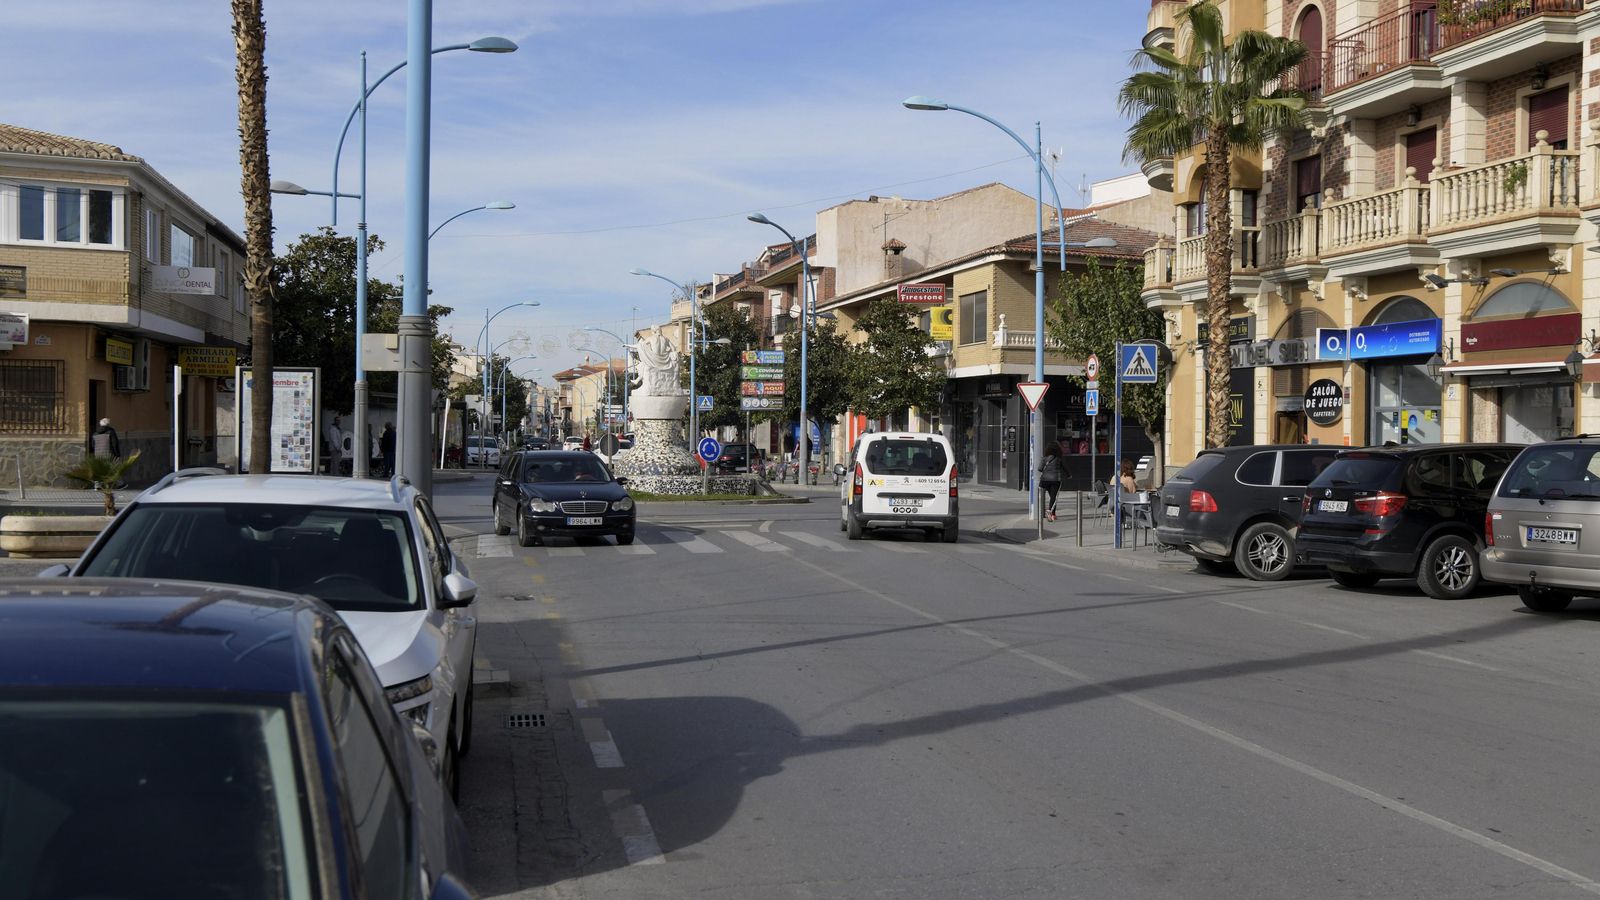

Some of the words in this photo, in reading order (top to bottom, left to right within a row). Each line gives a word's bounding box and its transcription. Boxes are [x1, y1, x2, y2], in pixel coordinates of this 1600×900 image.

[185, 280, 212, 288] DENTAL
[180, 347, 234, 356] FUNERARIA
[1279, 341, 1309, 363] SUR
[185, 355, 229, 363] ARMILLA
[1312, 383, 1336, 396] SALÓN
[1306, 399, 1316, 409] DE
[1318, 397, 1343, 408] JUEGO
